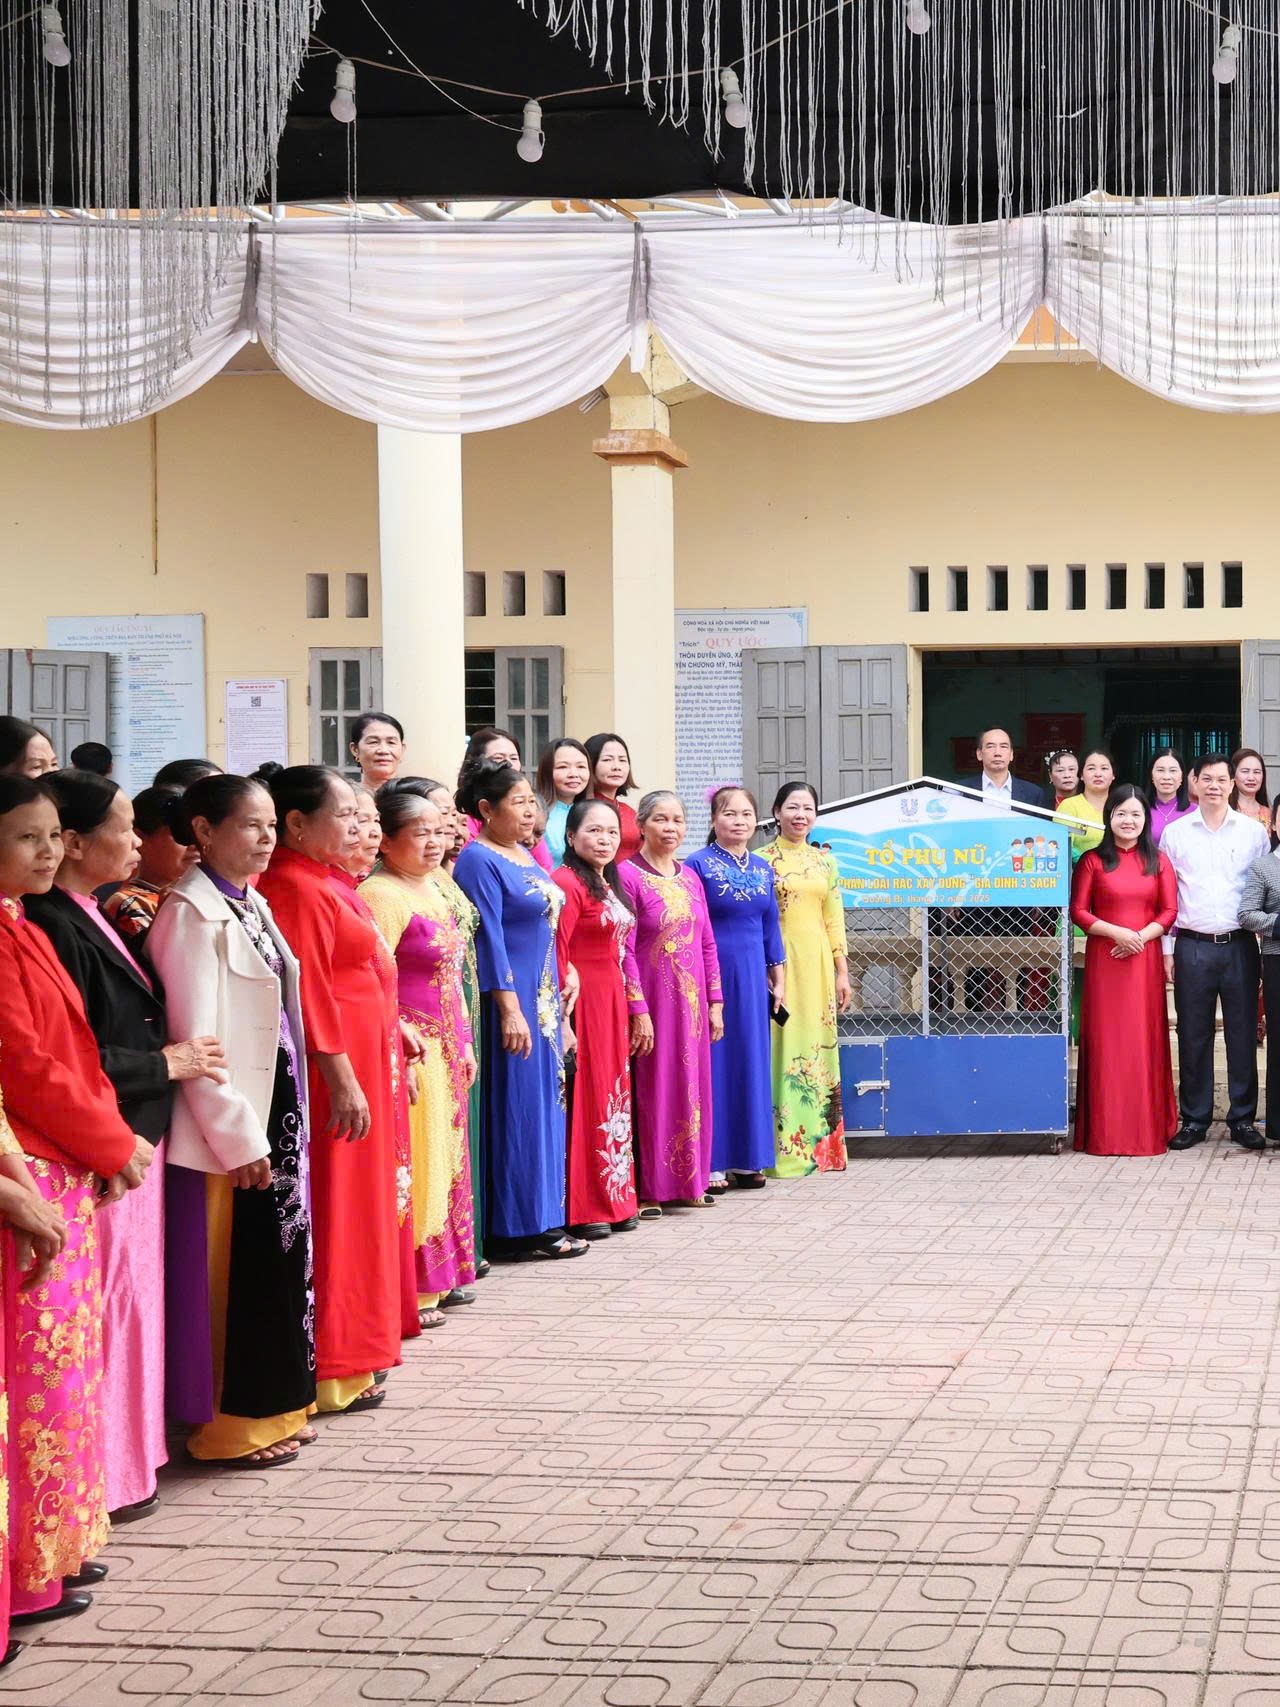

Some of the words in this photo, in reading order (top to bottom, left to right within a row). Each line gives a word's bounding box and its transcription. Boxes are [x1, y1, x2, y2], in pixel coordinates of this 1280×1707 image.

[865, 839, 895, 866] TỔ
[902, 846, 947, 870] PHỤ
[953, 842, 987, 866] NỮ
[1021, 878, 1027, 890] 3
